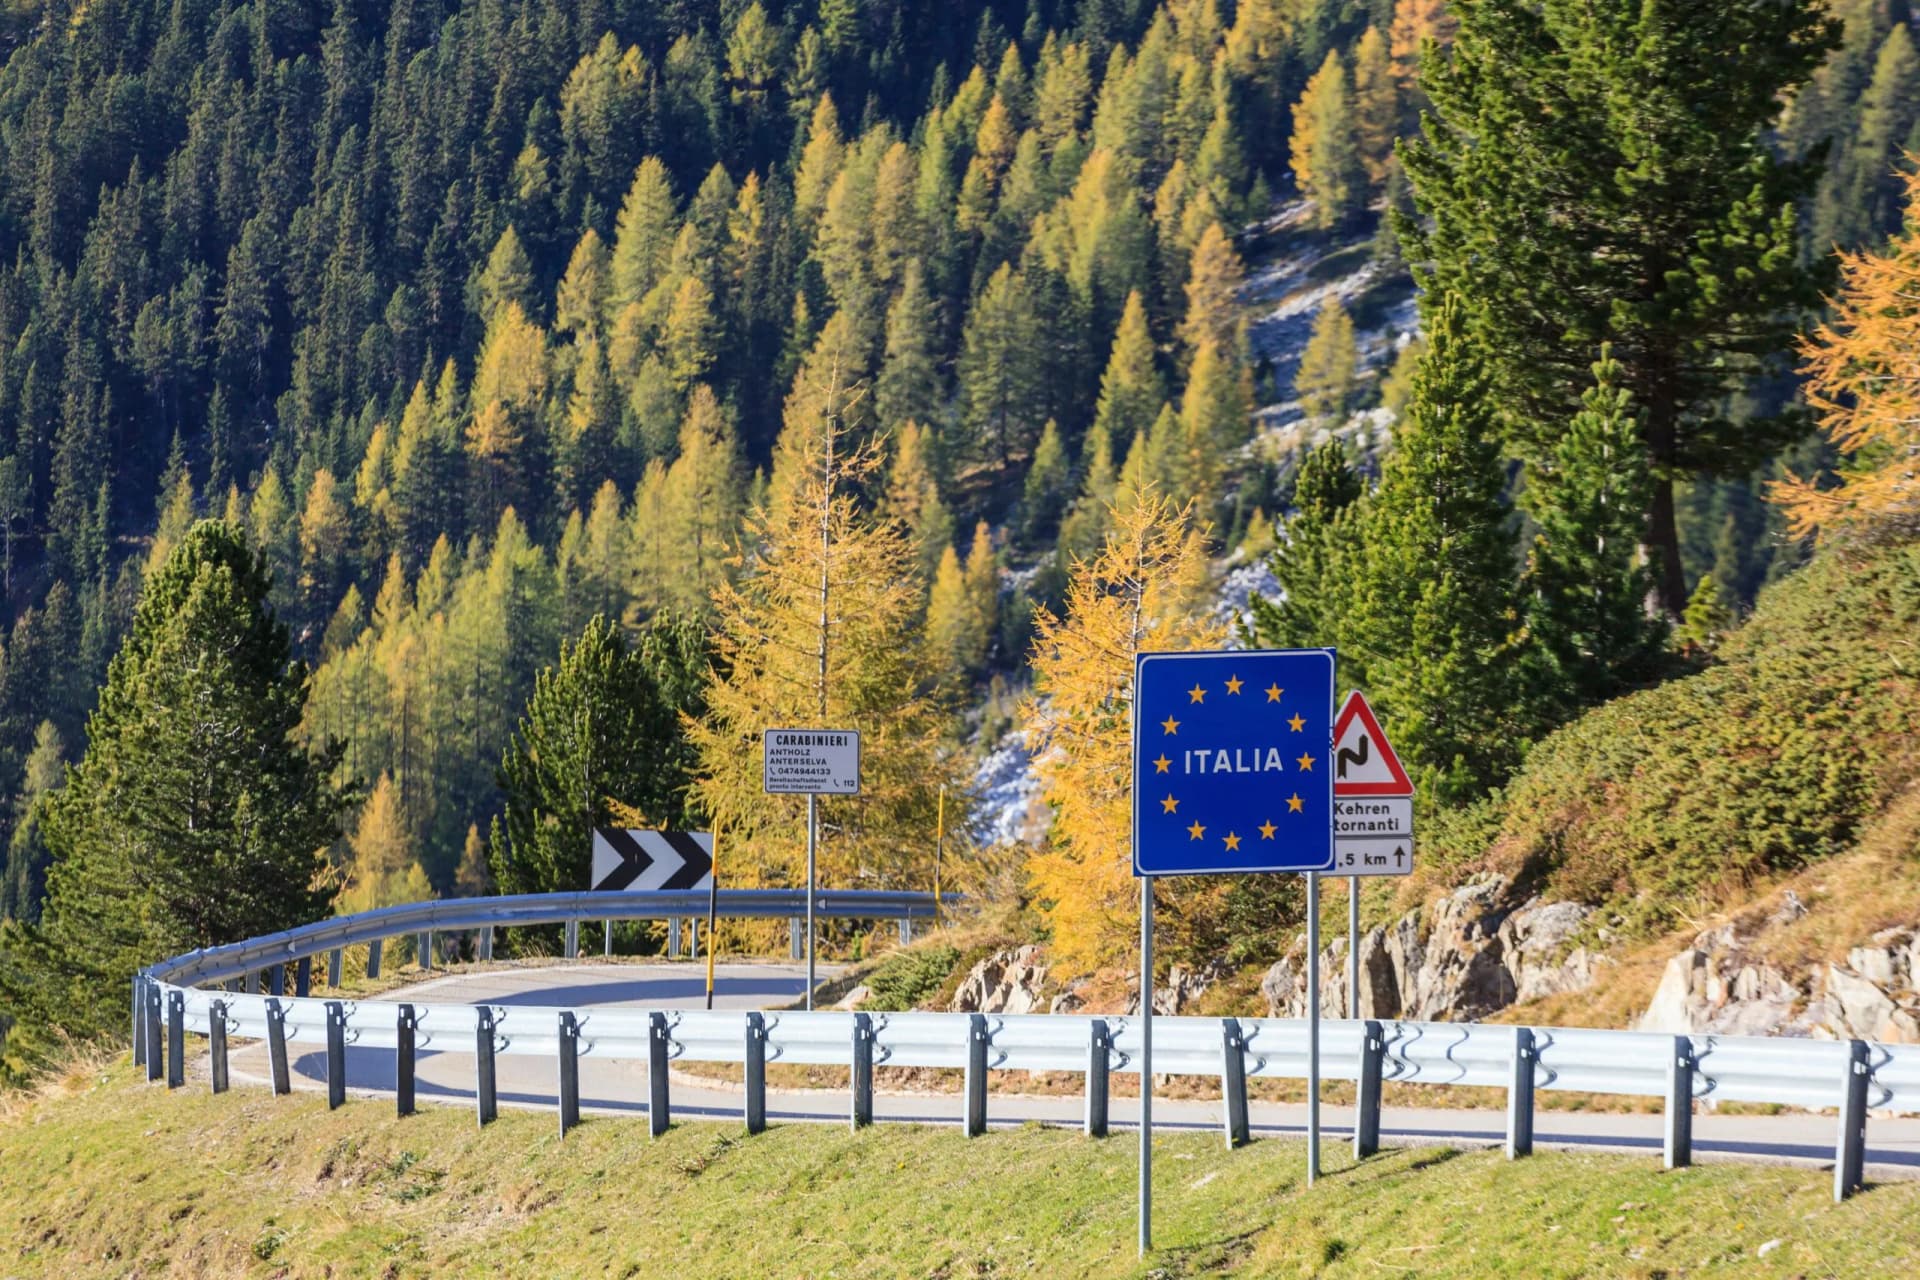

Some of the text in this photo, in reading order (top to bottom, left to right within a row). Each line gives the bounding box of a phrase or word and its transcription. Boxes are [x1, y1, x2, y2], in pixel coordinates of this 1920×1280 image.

[776, 735, 848, 746] CARABINIERI
[1185, 747, 1284, 774] ITALIA
[778, 767, 831, 775] 0474944133
[844, 779, 855, 787] 112
[1334, 802, 1390, 815] Kehren
[1334, 818, 1399, 831] tornanti
[1364, 853, 1387, 865] km
